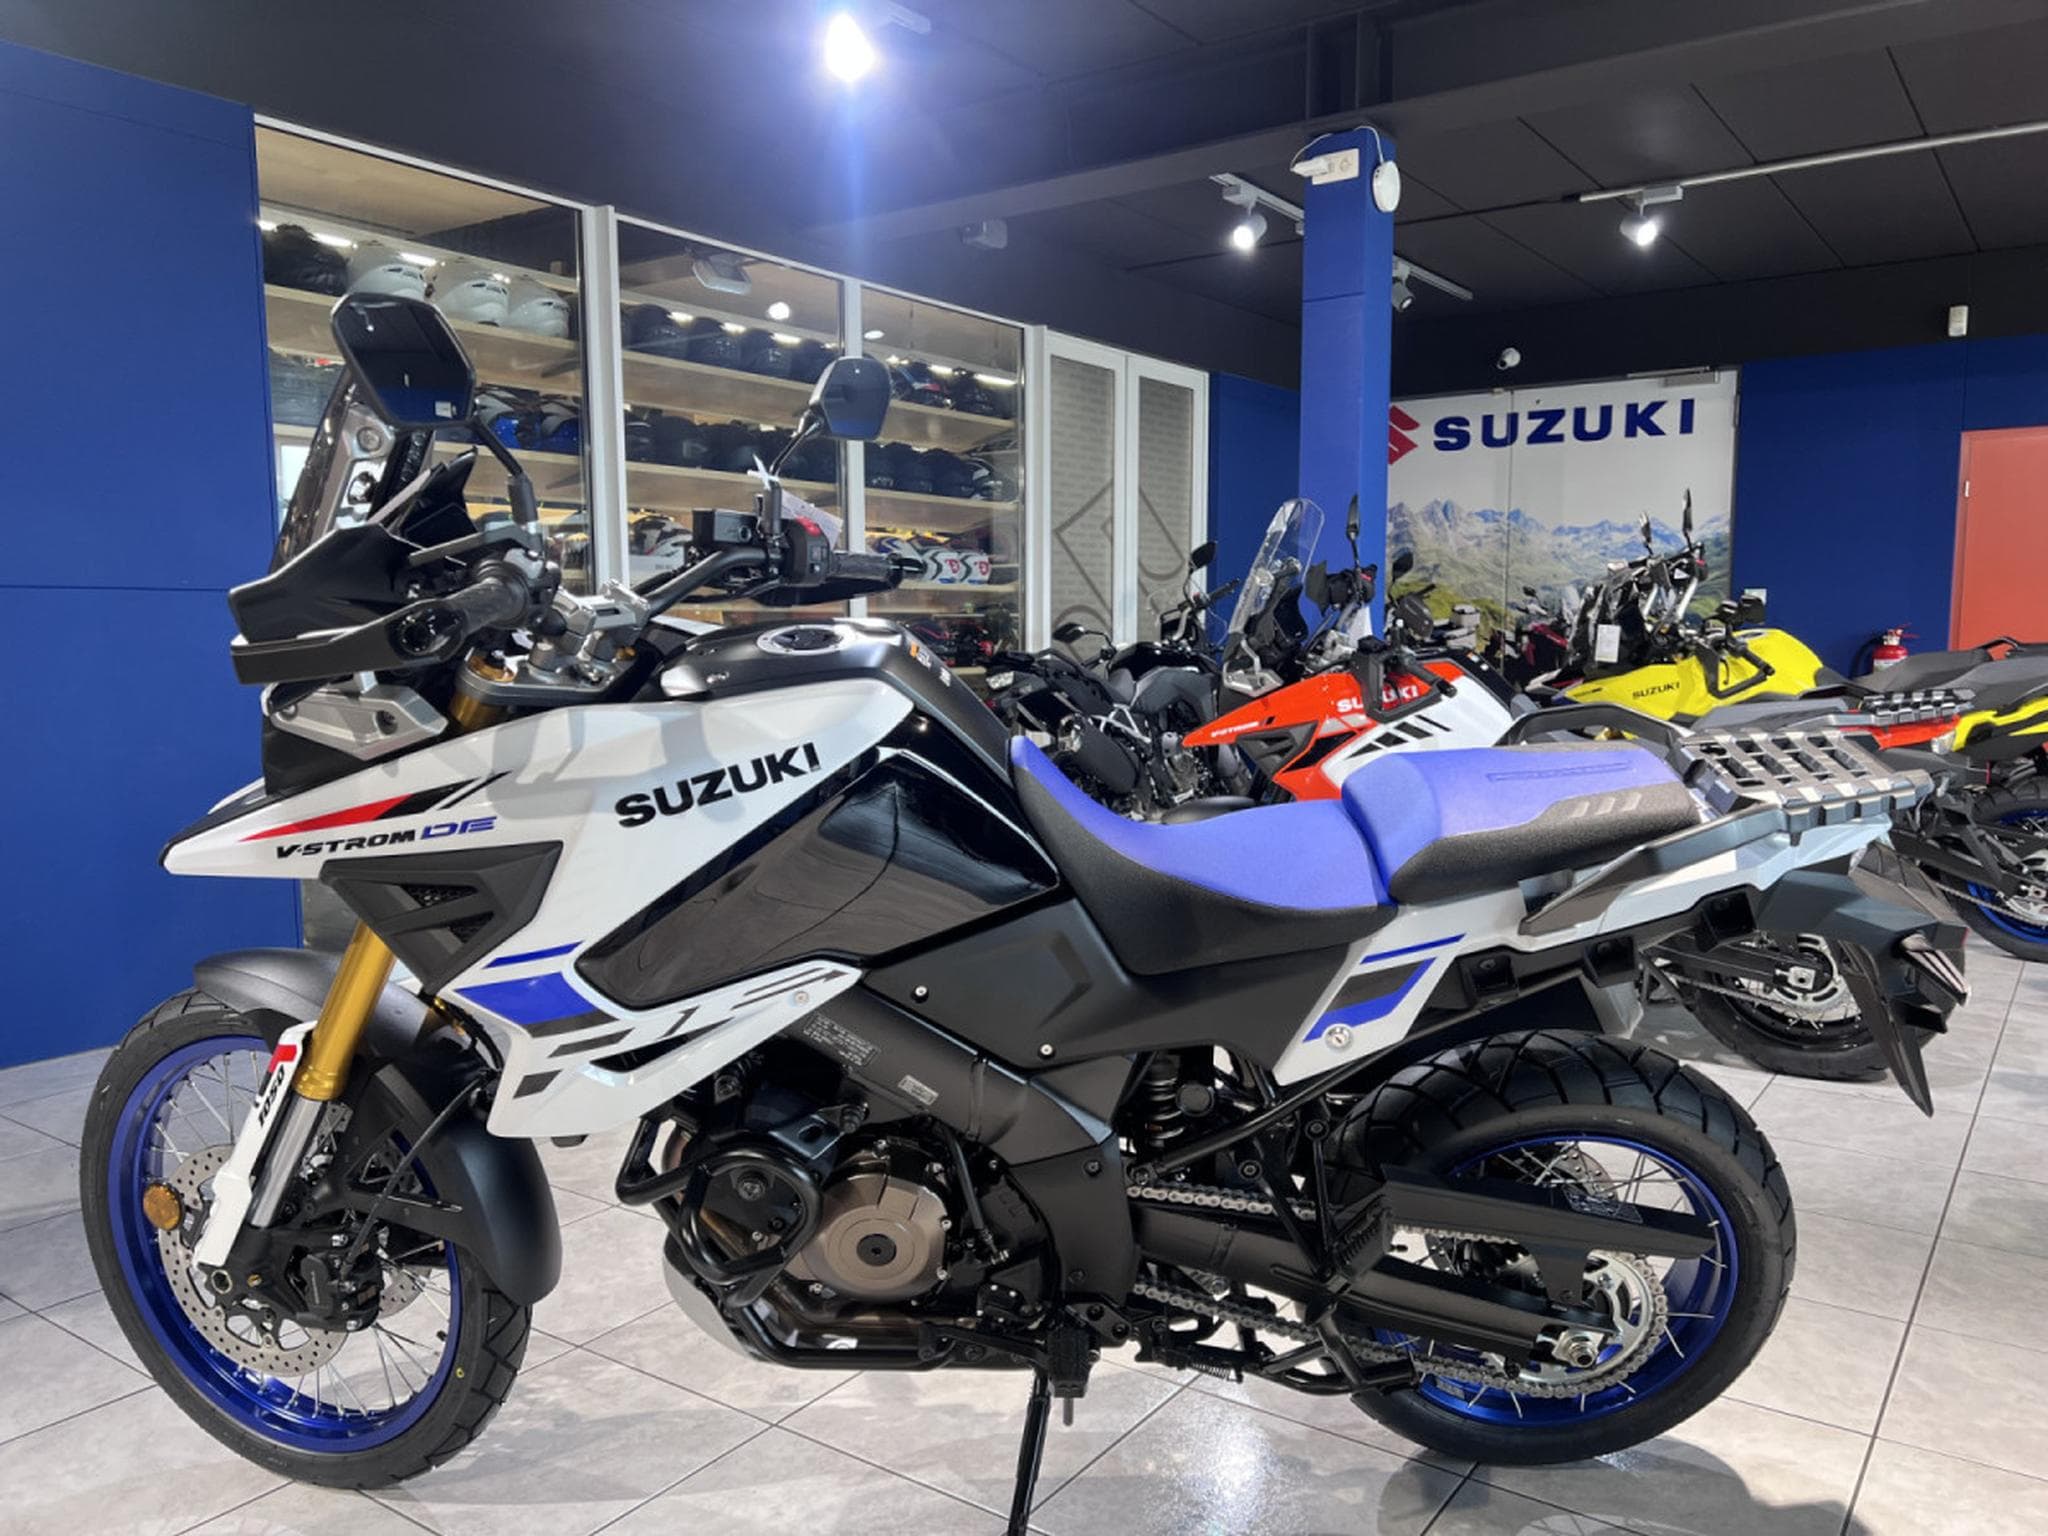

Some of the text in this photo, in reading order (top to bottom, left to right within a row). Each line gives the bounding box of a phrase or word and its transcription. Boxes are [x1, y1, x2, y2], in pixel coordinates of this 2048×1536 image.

[1433, 398, 1695, 451] SUZUKI
[1632, 681, 1680, 700] SUZUKI
[614, 742, 822, 828] SUZUKI
[420, 816, 498, 841] DE
[258, 1064, 285, 1128] 1050
